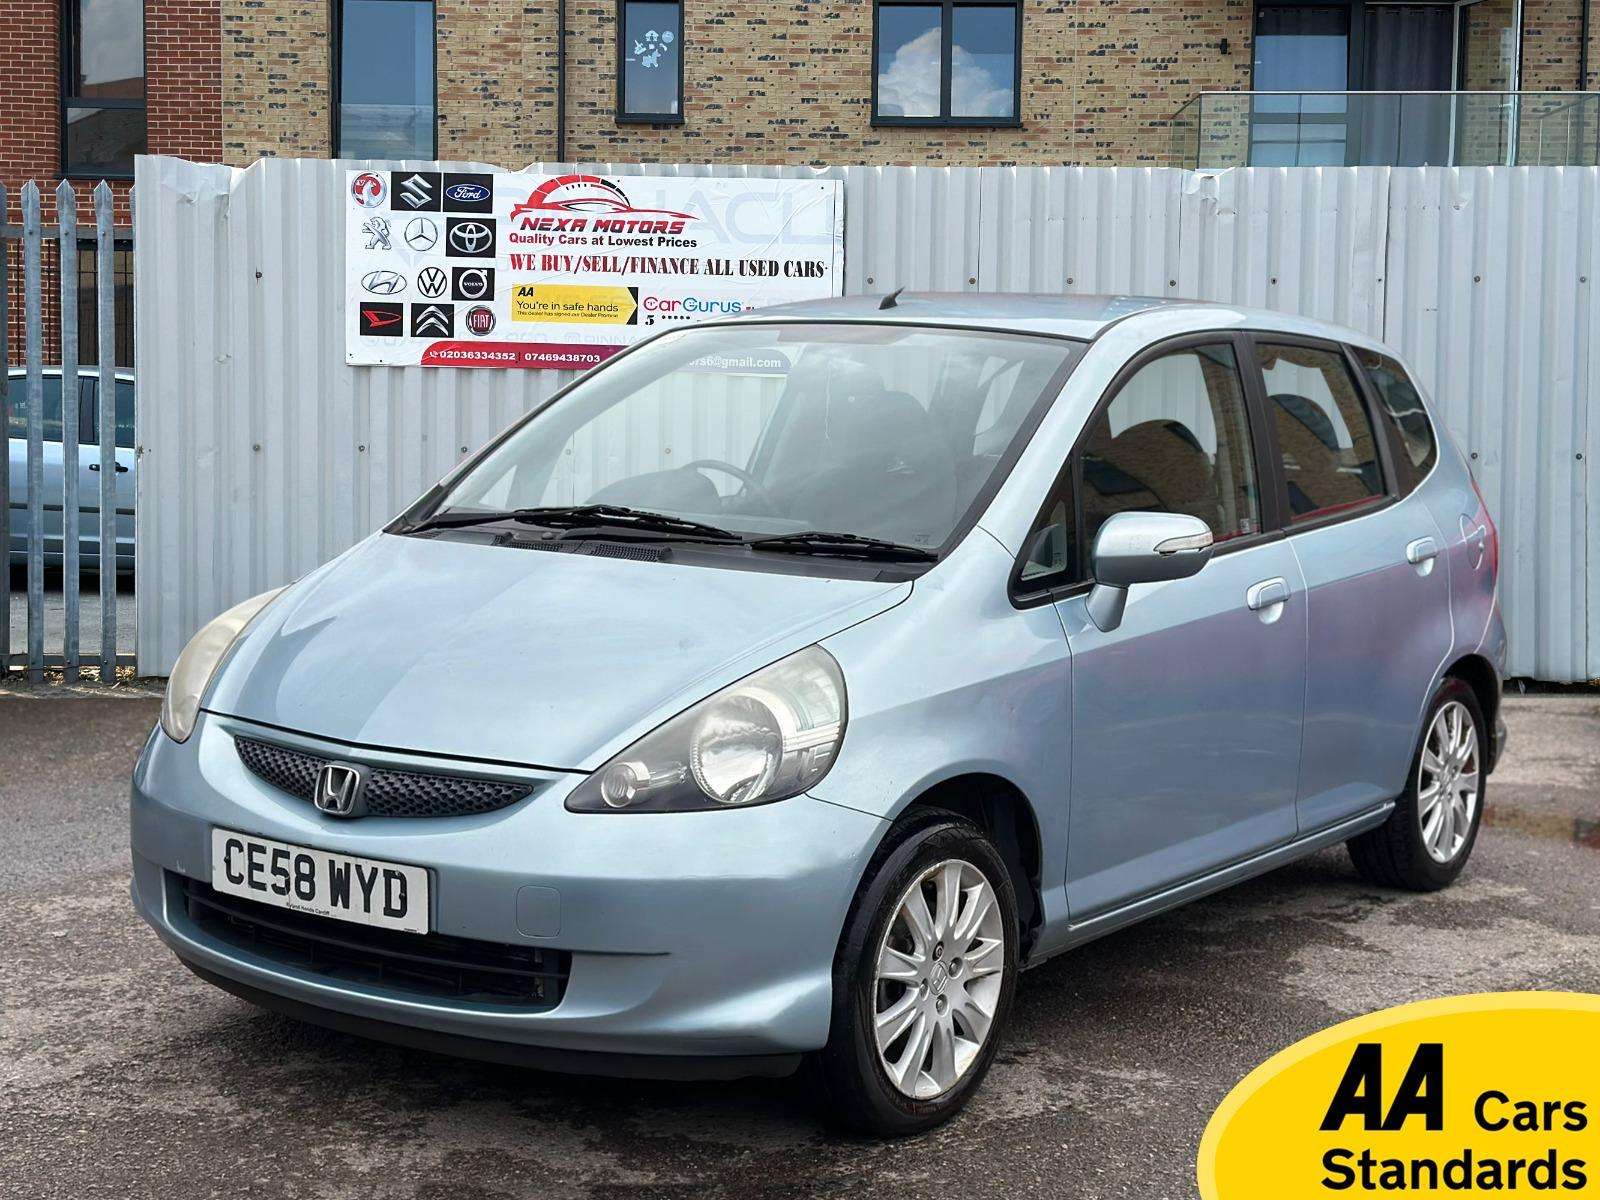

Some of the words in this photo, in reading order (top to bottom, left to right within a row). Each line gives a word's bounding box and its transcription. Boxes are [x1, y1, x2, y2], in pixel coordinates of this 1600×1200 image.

[454, 187, 481, 199] Ford
[520, 217, 588, 232] NEXA
[592, 219, 686, 235] MOTORS
[509, 233, 554, 246] Quality
[560, 234, 588, 245] Cars
[591, 235, 604, 246] at
[608, 235, 654, 247] Lowest
[657, 237, 698, 248] Prices
[509, 253, 536, 271] WE
[541, 254, 699, 276] BUY/SELL/FINANCE
[704, 258, 735, 276] ALL
[739, 259, 780, 277] USED
[784, 260, 825, 278] CARS
[518, 287, 534, 297] AA
[517, 301, 549, 310] You're
[551, 301, 560, 310] in
[562, 302, 584, 311] safe
[587, 303, 618, 312] hands
[644, 296, 742, 313] CarGurus
[473, 314, 489, 328] FIAT
[440, 351, 516, 360] 02036334352
[525, 353, 601, 362] 07469438703
[224, 838, 315, 901] CE58
[328, 859, 408, 919] WYD
